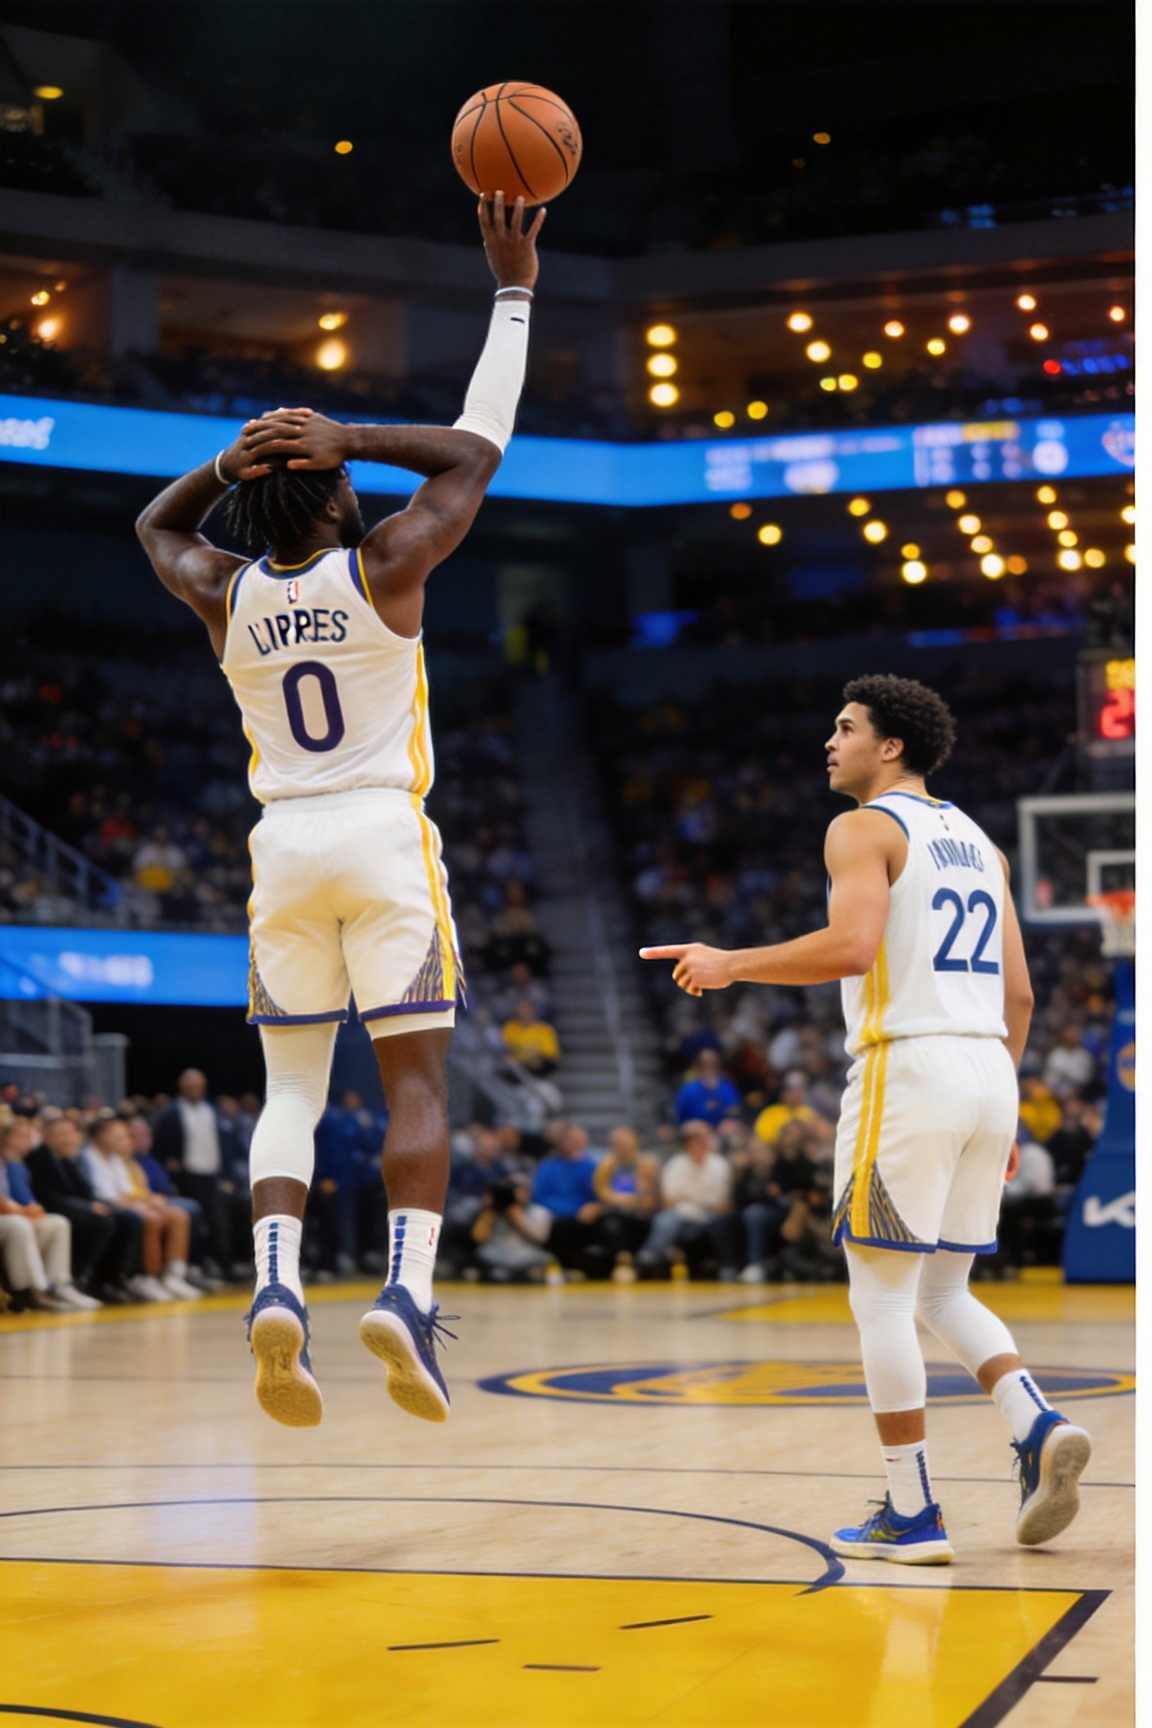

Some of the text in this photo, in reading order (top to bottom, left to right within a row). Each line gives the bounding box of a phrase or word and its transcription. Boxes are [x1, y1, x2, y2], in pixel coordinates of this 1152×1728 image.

[282, 660, 345, 753] 0
[1100, 689, 1135, 739] 2
[932, 887, 1000, 975] 22
